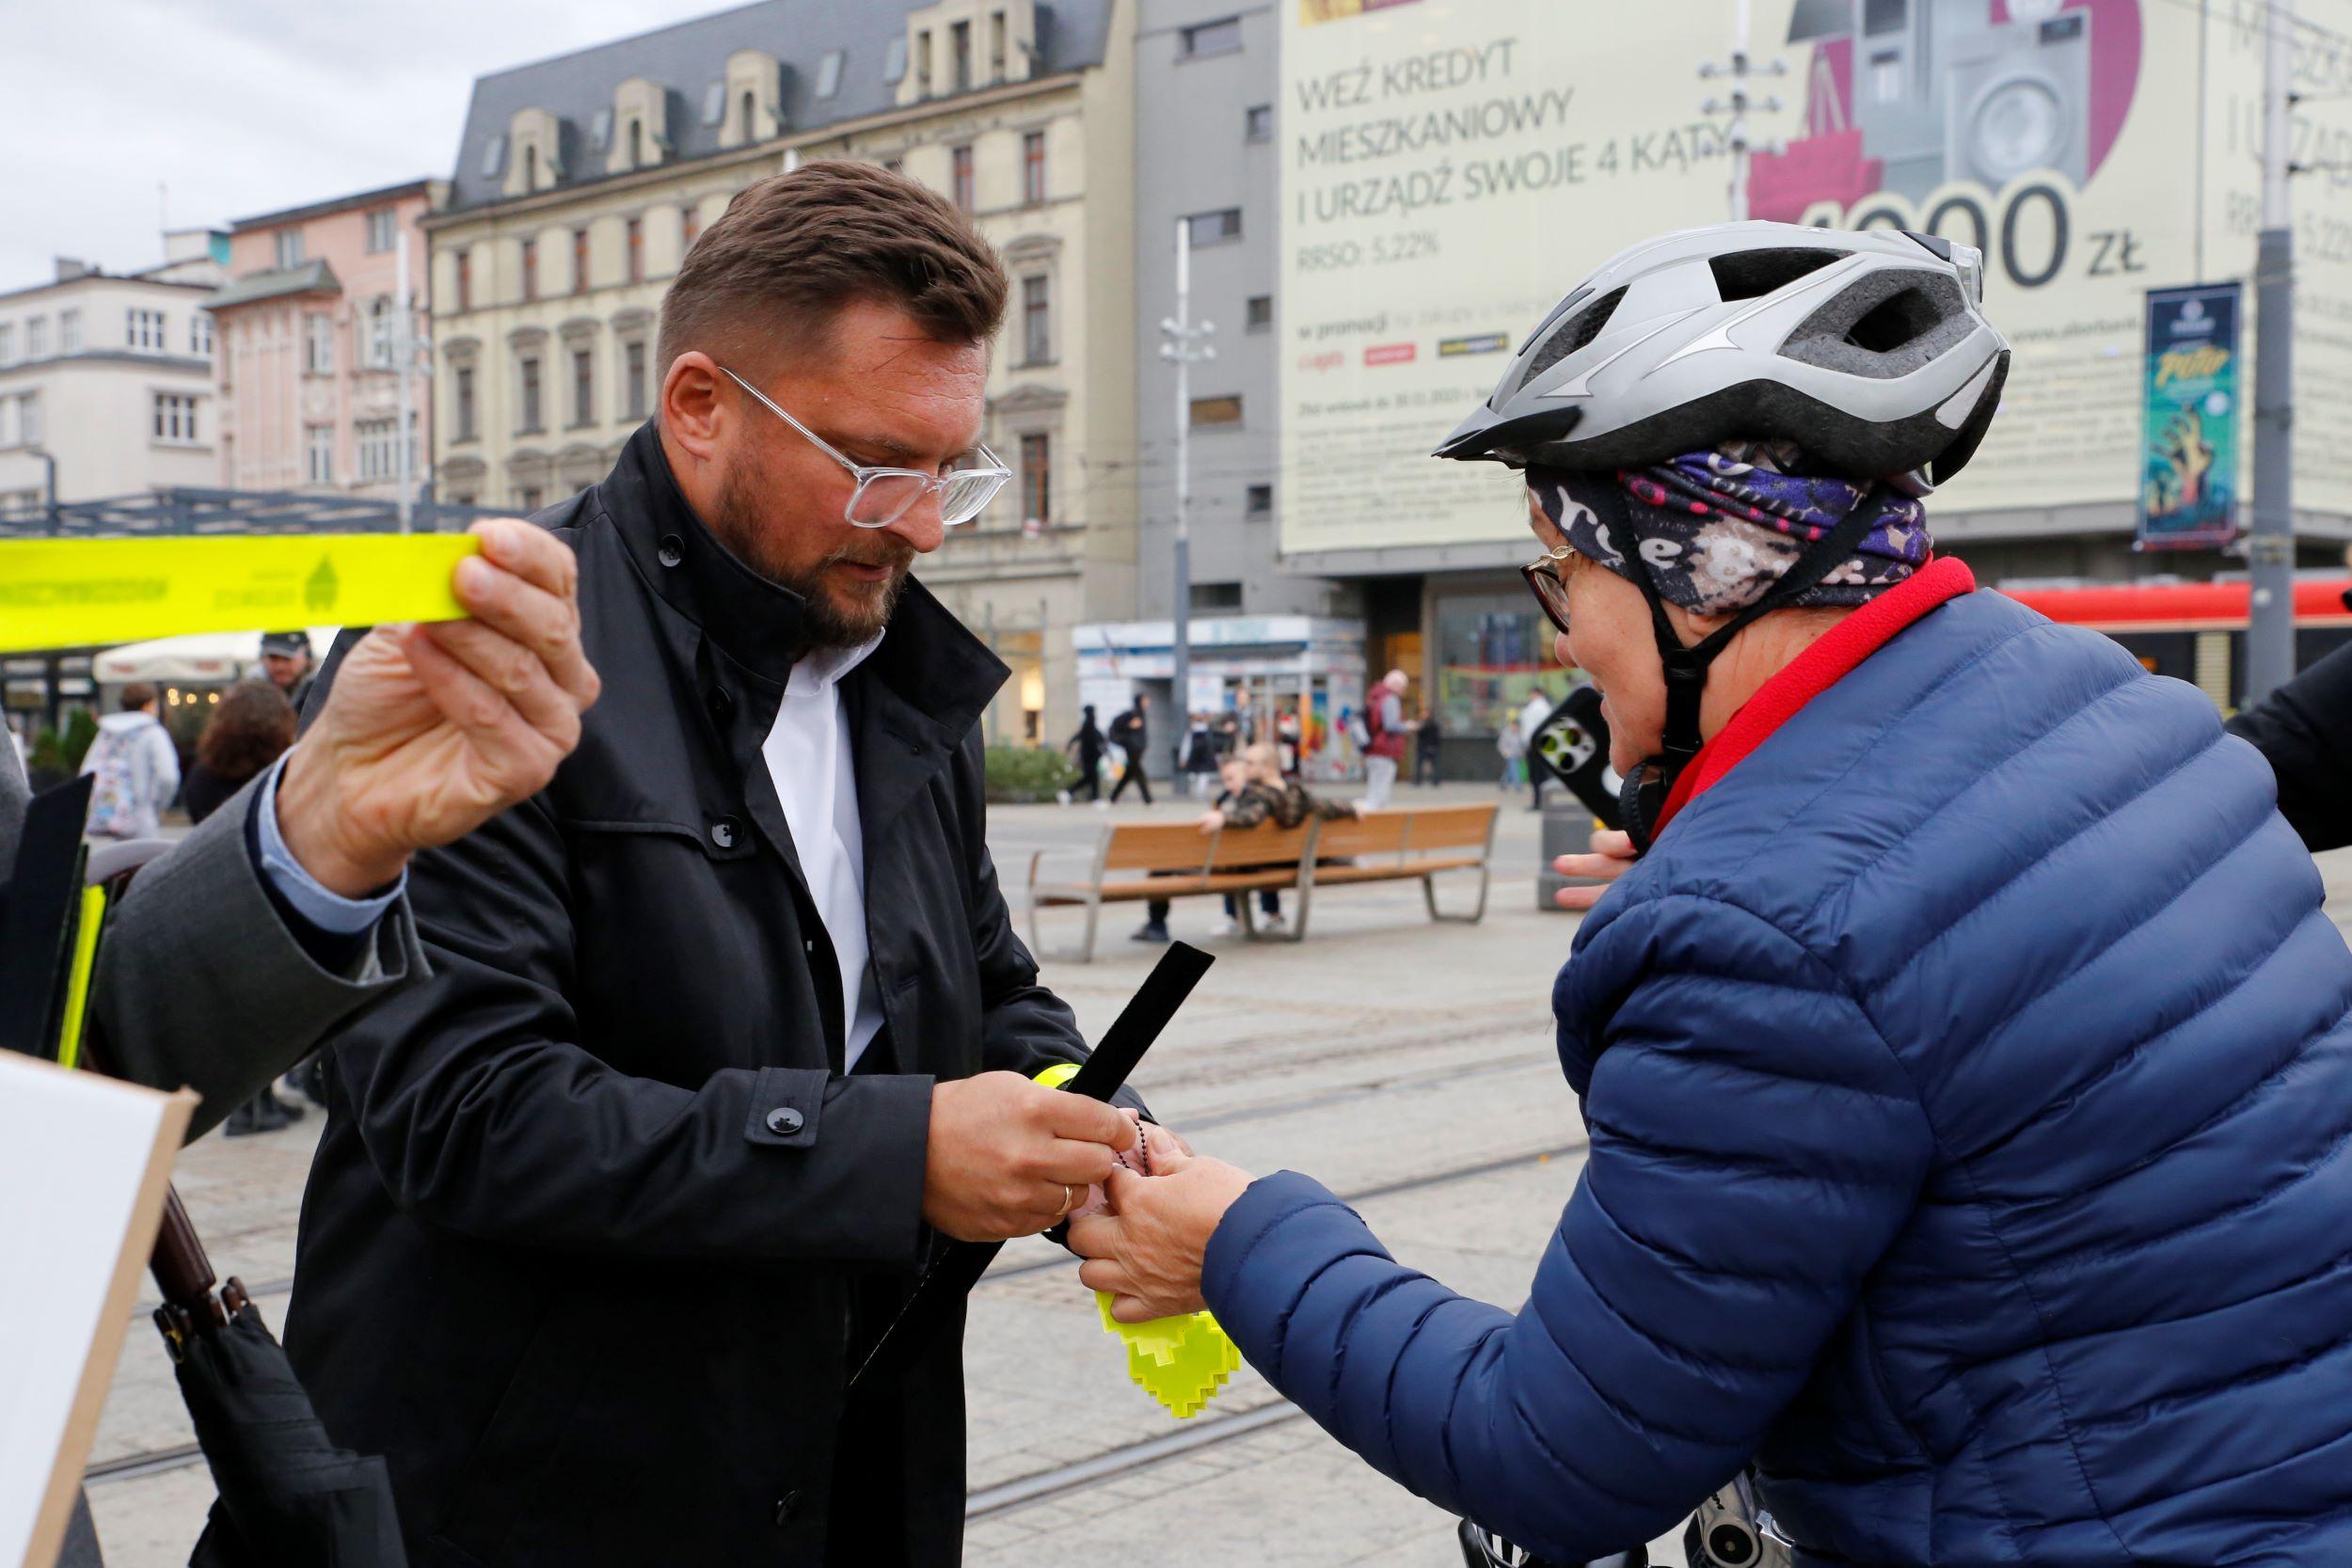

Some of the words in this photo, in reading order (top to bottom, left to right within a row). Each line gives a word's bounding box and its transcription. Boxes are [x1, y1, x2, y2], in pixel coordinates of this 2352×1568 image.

[1296, 56, 1373, 113] WEŹ
[1382, 38, 1518, 99] KREDYT
[1297, 87, 1576, 169] MIESZKANIOWY
[1296, 192, 1307, 226] I
[1313, 159, 1454, 224] URZĄDŹ
[1464, 142, 1587, 201] SWOJE
[1596, 138, 1618, 178] 4
